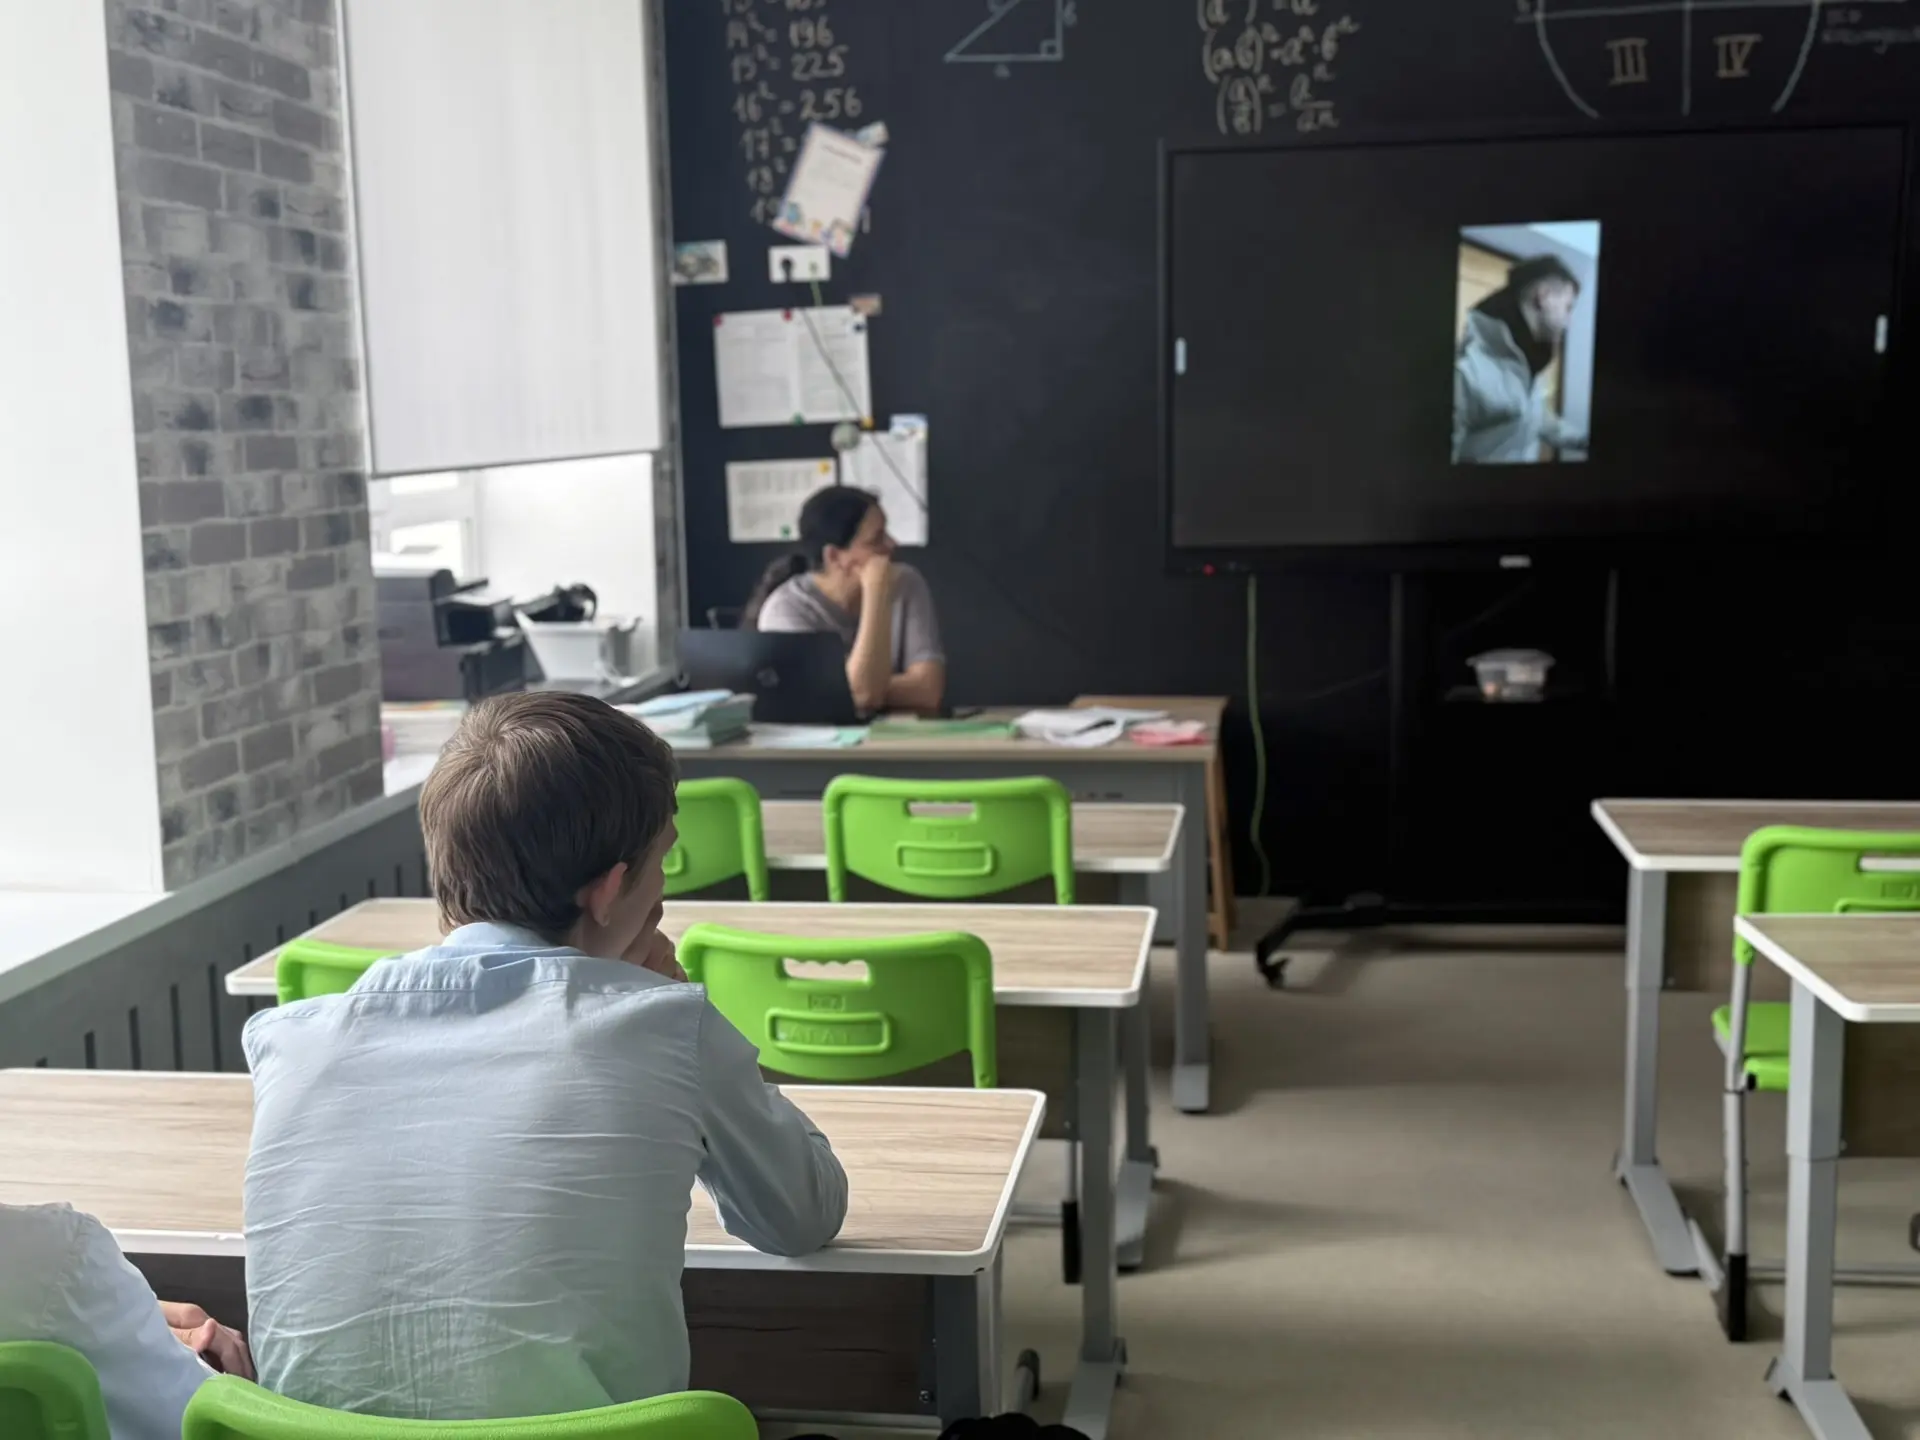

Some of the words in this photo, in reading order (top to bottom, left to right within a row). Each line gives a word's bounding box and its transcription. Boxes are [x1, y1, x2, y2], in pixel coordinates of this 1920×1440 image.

[789, 15, 834, 48] 196
[791, 44, 850, 81] 225
[1713, 33, 1763, 79] IV
[799, 86, 862, 120] 256
